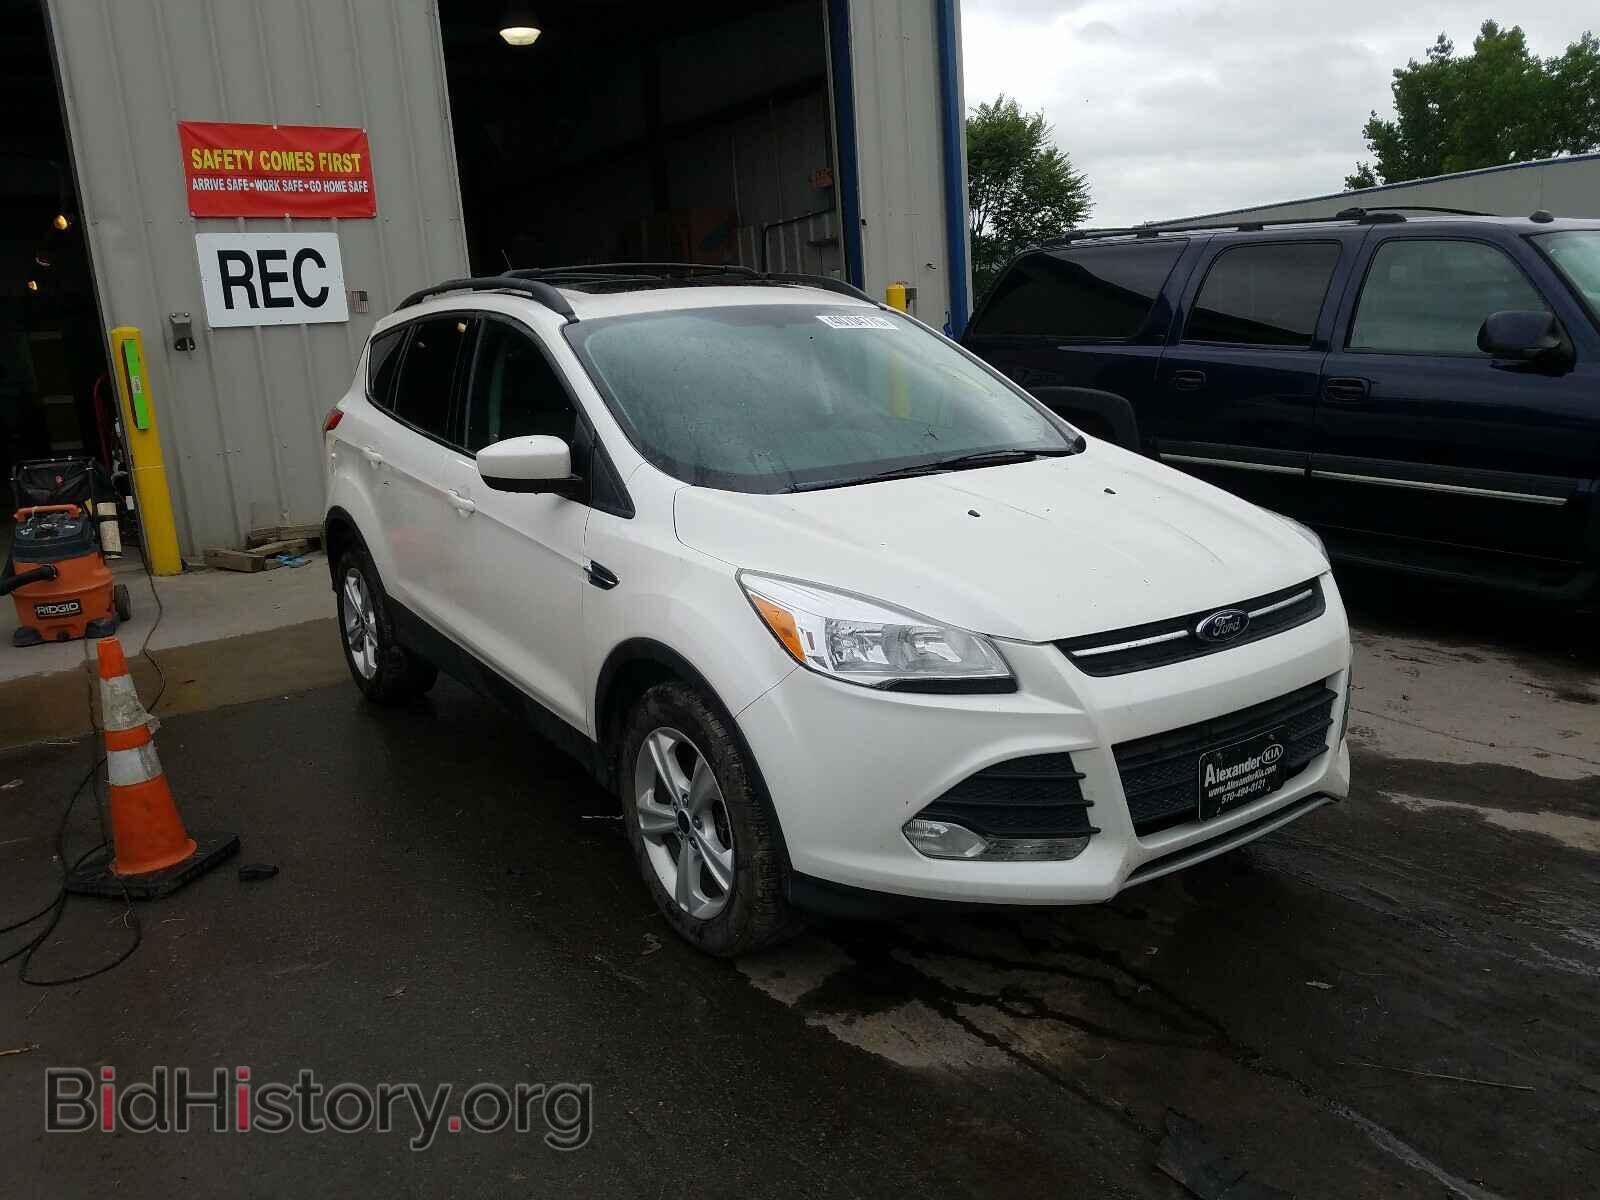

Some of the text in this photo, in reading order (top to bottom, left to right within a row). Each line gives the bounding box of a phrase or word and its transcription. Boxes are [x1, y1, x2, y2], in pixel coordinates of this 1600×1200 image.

[191, 148, 361, 173] SAFETY COMES FIRST
[192, 178, 226, 191] ARRIVE
[323, 180, 348, 193] HOME
[349, 180, 369, 193] SAFE
[216, 248, 330, 310] REC
[37, 602, 79, 615] RIDGID
[1212, 614, 1241, 636] Ford
[1204, 746, 1281, 787] Alexander KIA
